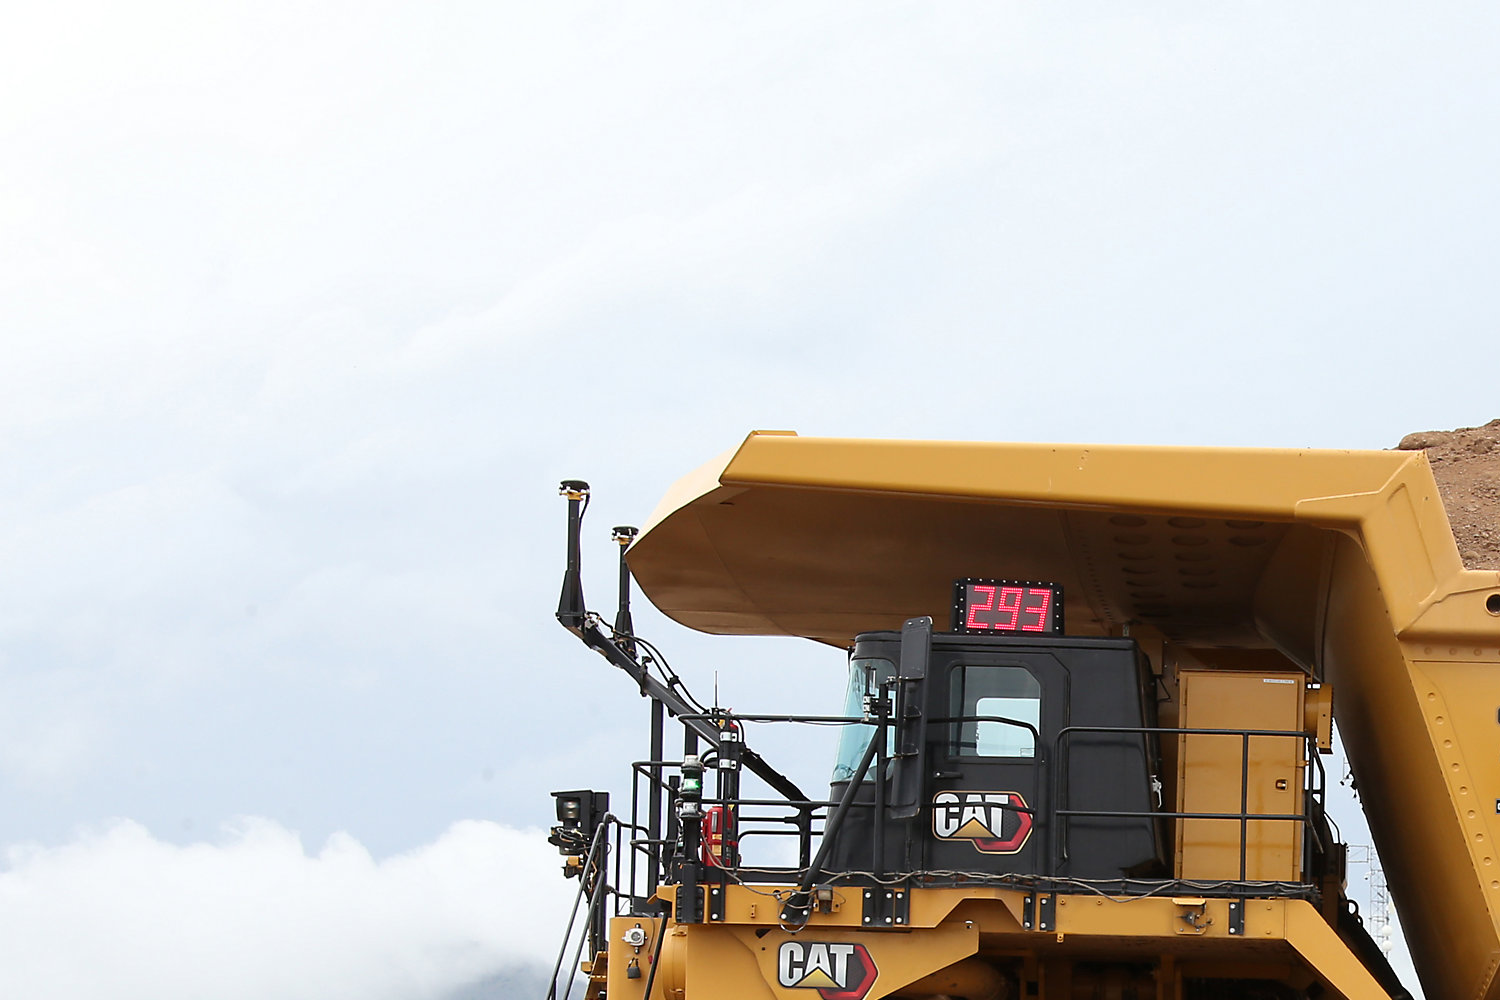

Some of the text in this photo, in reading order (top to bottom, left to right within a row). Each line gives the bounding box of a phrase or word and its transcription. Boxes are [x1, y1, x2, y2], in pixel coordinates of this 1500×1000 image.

[966, 585, 1050, 632] 293
[935, 793, 1009, 838] CAT
[779, 942, 854, 988] CAT
